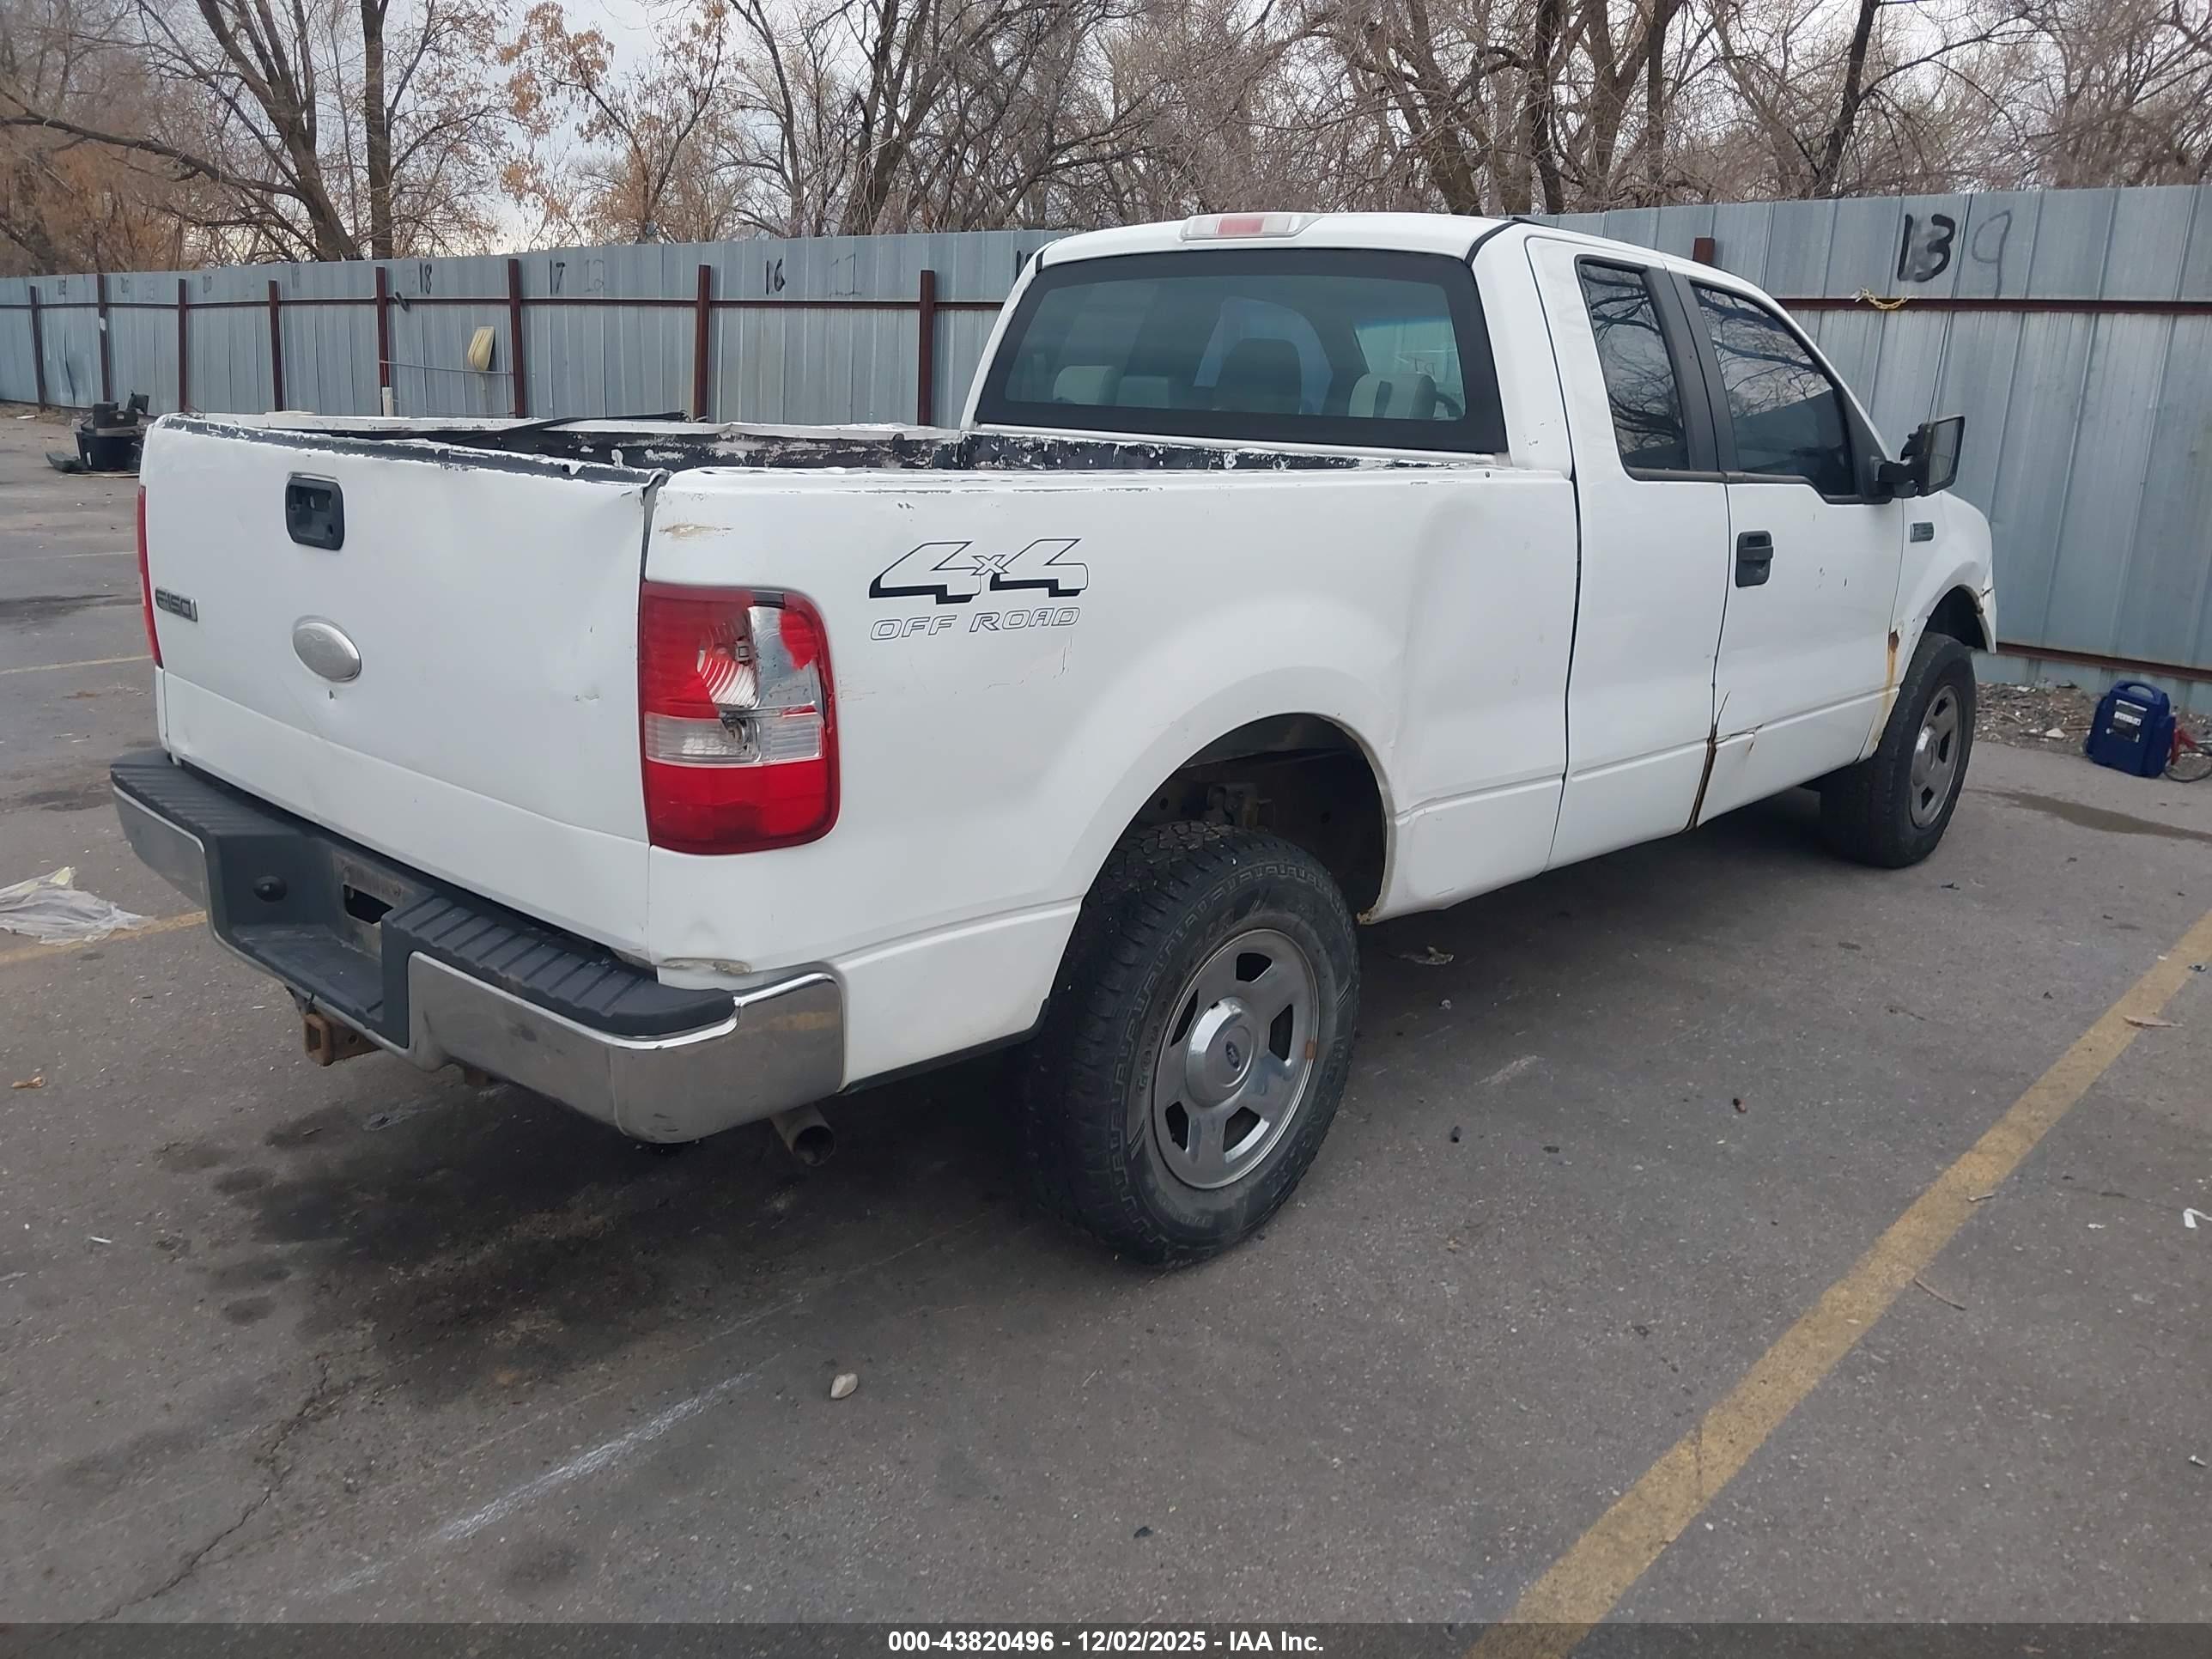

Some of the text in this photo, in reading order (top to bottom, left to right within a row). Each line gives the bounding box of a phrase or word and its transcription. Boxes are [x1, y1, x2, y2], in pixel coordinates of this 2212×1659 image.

[419, 261, 433, 295] 18
[549, 258, 566, 296] 17
[765, 257, 786, 295] 16
[870, 606, 1081, 641] OFF ROAD
